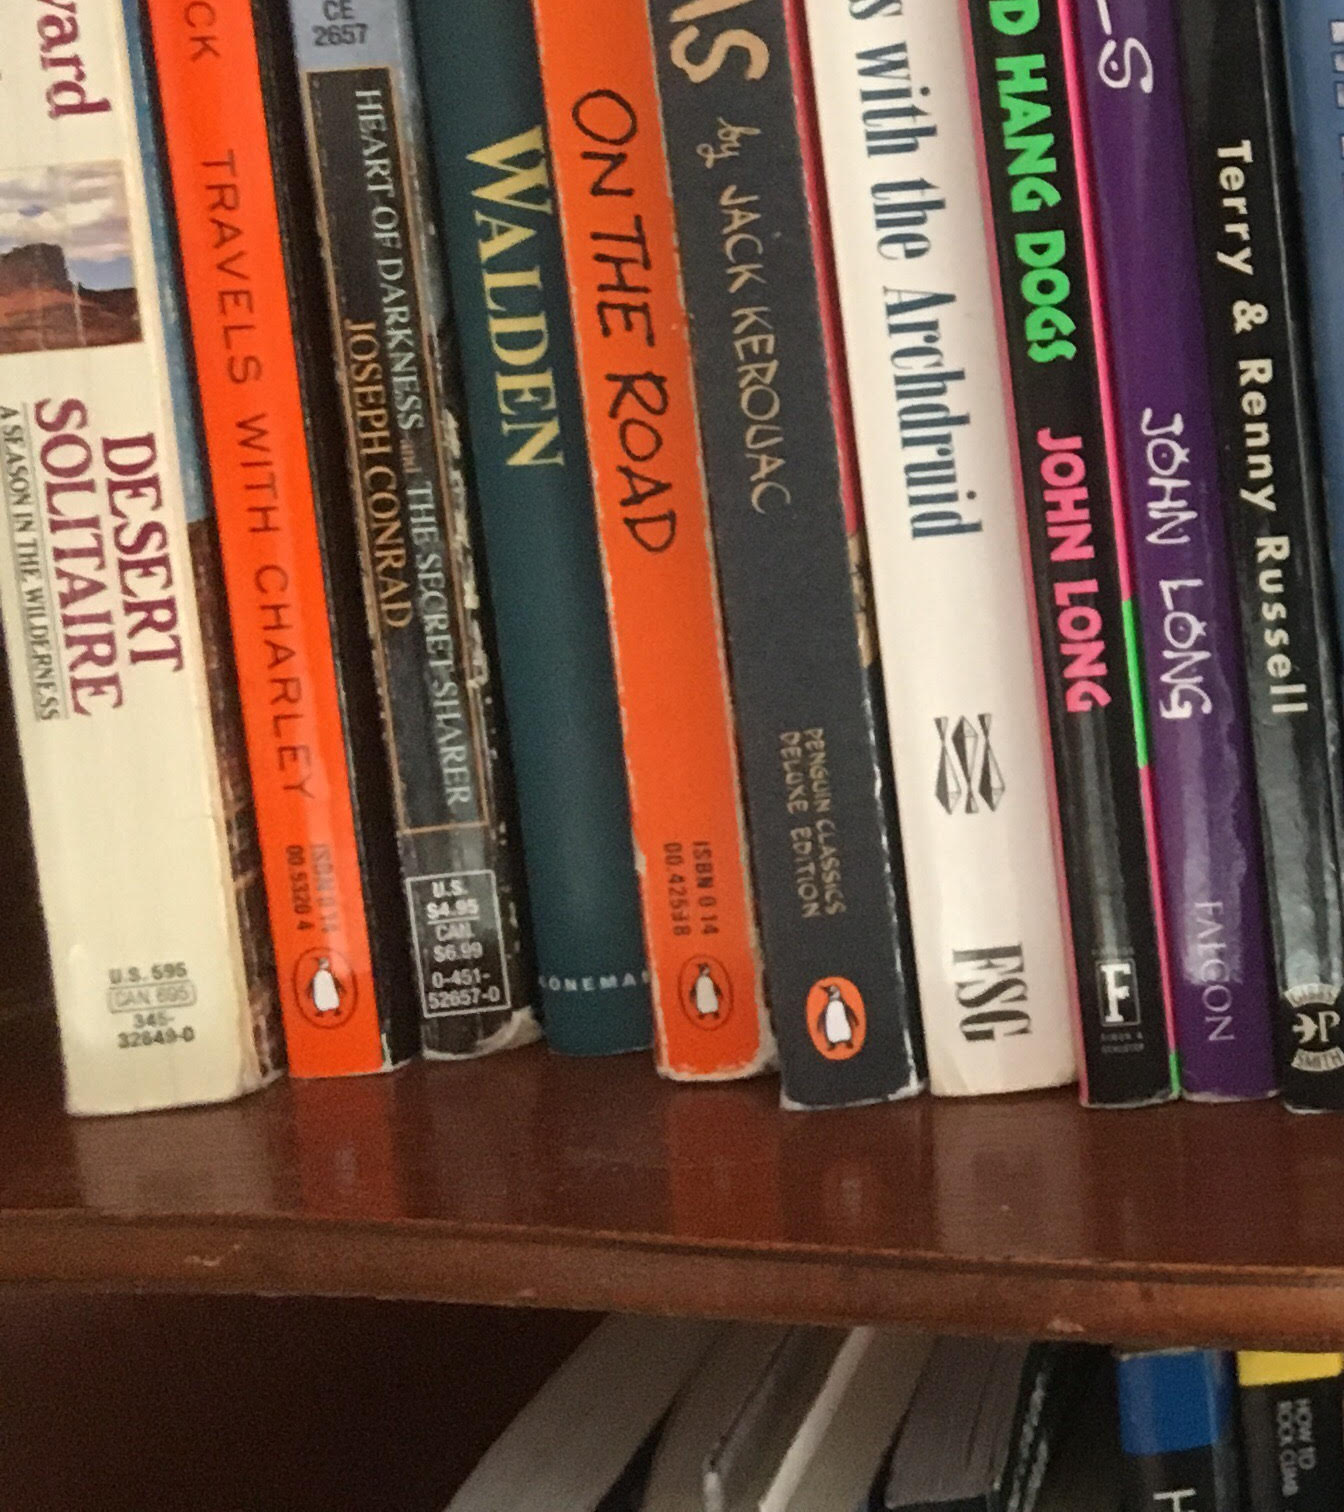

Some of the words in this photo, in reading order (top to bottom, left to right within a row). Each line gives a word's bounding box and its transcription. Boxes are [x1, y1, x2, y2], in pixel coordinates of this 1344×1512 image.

[314, 24, 366, 46] 2657
[855, 41, 937, 157] with
[571, 90, 638, 197] ON
[995, 54, 1062, 214] HANG
[201, 150, 262, 385] TRAVELS
[591, 214, 654, 346] THE
[870, 179, 946, 261] the
[466, 125, 564, 467] WALDEN
[1015, 229, 1077, 363] DOGS
[3, 425, 31, 505] SEASON
[235, 413, 282, 534] WITH
[605, 371, 678, 554] ROAD
[882, 285, 983, 539] Archdruid
[13, 512, 34, 533] IN
[34, 397, 125, 716] SOLITAIRE
[102, 432, 183, 672] DESERT
[1037, 427, 1096, 562] JOHN
[16, 541, 41, 583] THE
[25, 587, 60, 721] WILDERNESS
[255, 565, 314, 799] CHARLEY
[1052, 578, 1113, 714] LONG
[780, 732, 809, 811] DELUXE
[803, 728, 832, 815] PENGUIN
[791, 826, 821, 918] EDITION
[817, 819, 847, 915] CLASSICS
